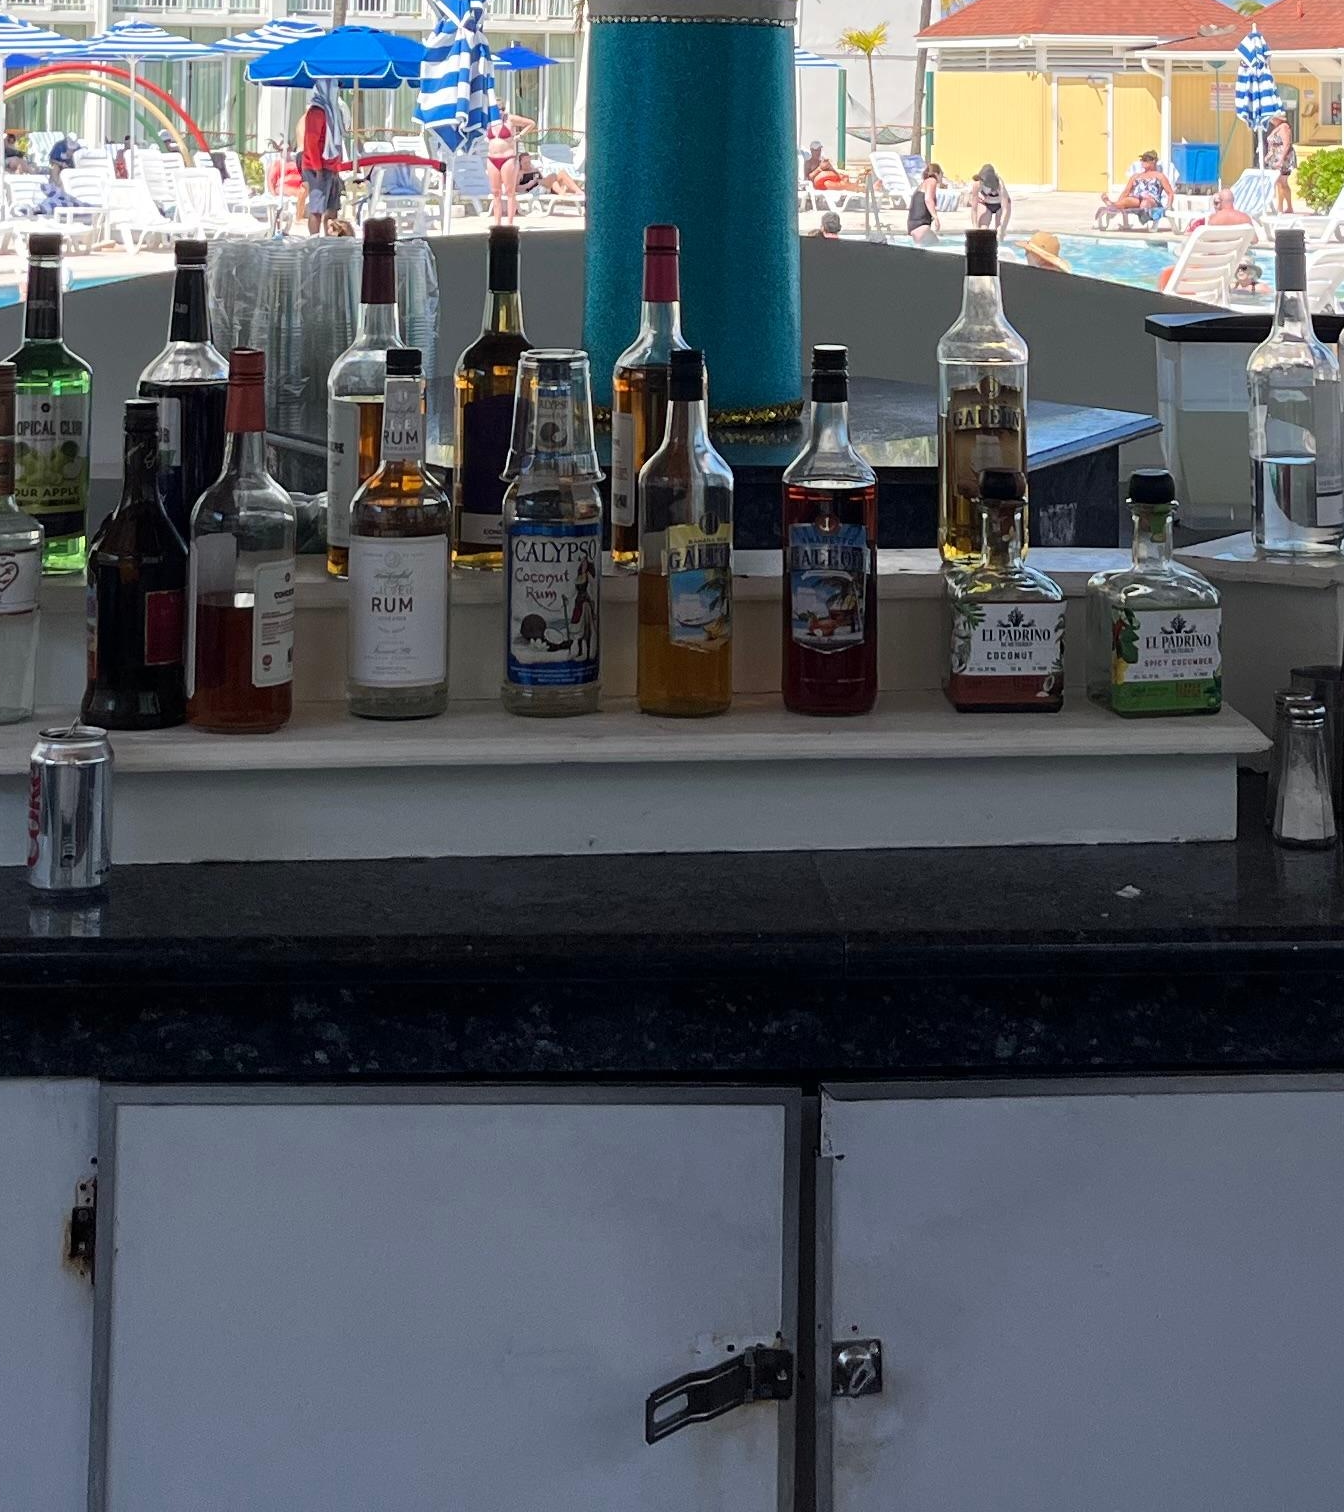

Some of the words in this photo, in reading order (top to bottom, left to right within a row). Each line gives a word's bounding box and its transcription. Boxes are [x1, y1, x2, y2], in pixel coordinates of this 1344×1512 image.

[17, 421, 56, 436] OPICAL
[383, 430, 419, 445] RUM
[515, 539, 597, 563] CALYPSO
[515, 567, 570, 588] Coconut
[526, 586, 558, 605] Rum
[371, 596, 414, 613] RUM
[982, 629, 996, 642] EL
[999, 629, 1051, 642] PADRINO
[1145, 636, 1158, 649] EL
[1161, 633, 1212, 649] PADRINO
[986, 651, 1034, 661] COCONUT
[1144, 659, 1168, 667] SPICY
[1171, 657, 1213, 666] CUCUMBER
